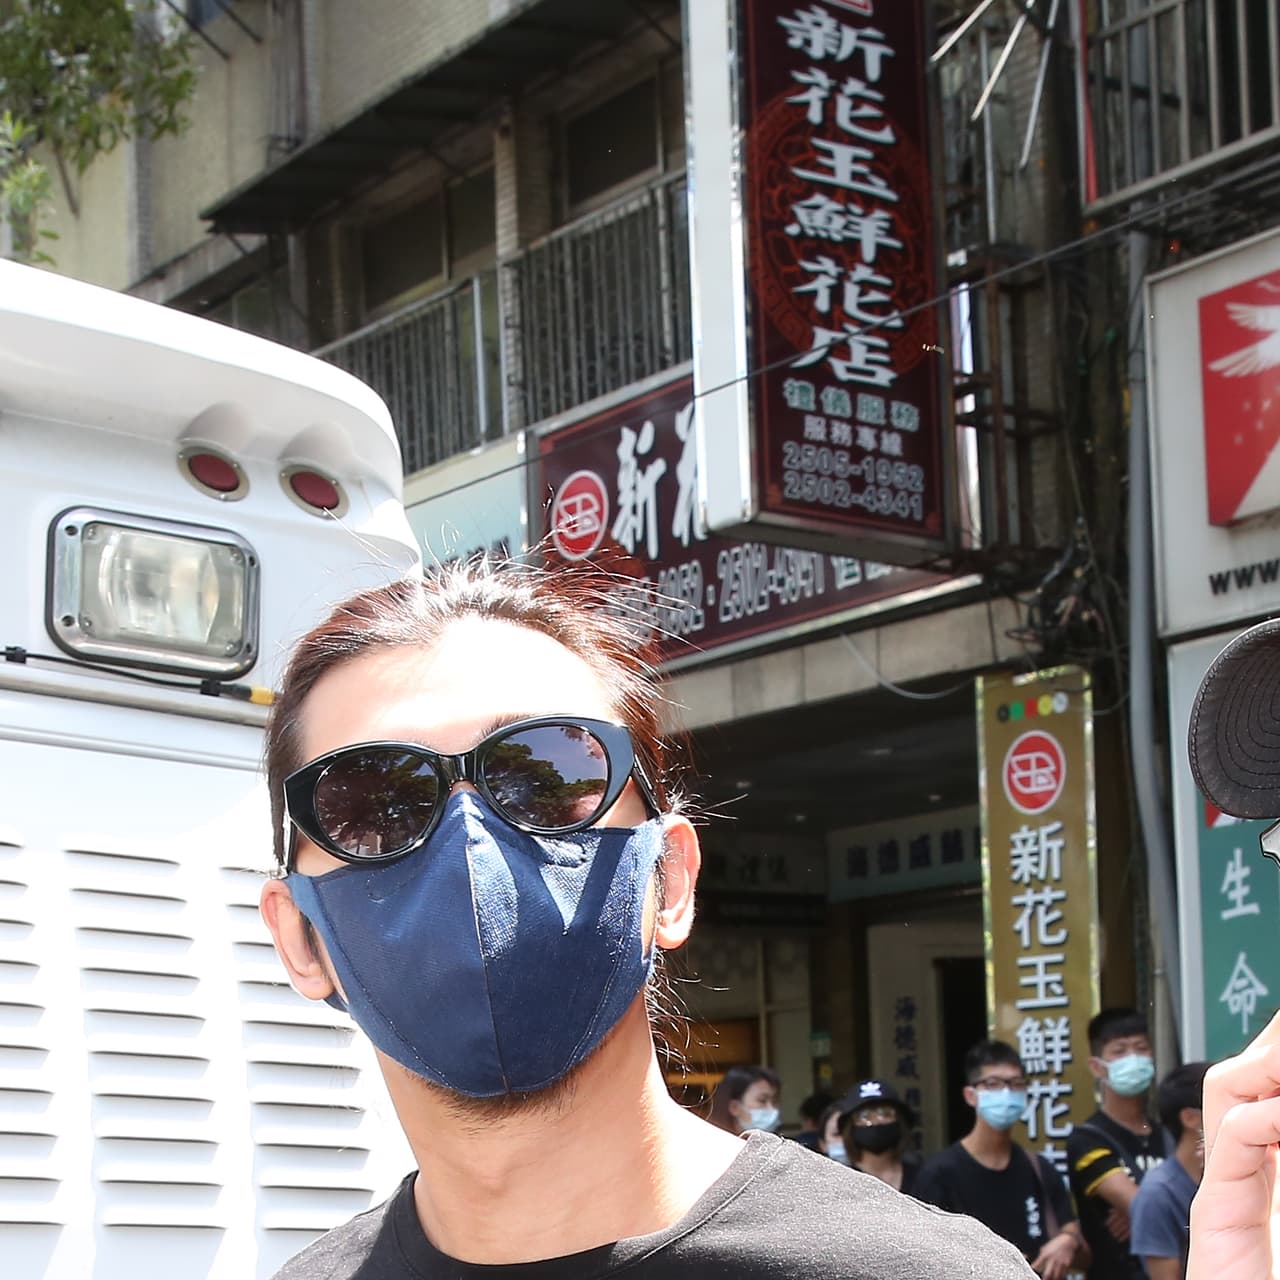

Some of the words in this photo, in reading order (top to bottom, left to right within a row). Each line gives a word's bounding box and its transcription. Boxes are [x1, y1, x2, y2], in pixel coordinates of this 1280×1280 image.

[777, 4, 904, 388] 新花玉鮮花店
[783, 470, 924, 521] 2502-4341
[1220, 848, 1269, 1035] 生命
